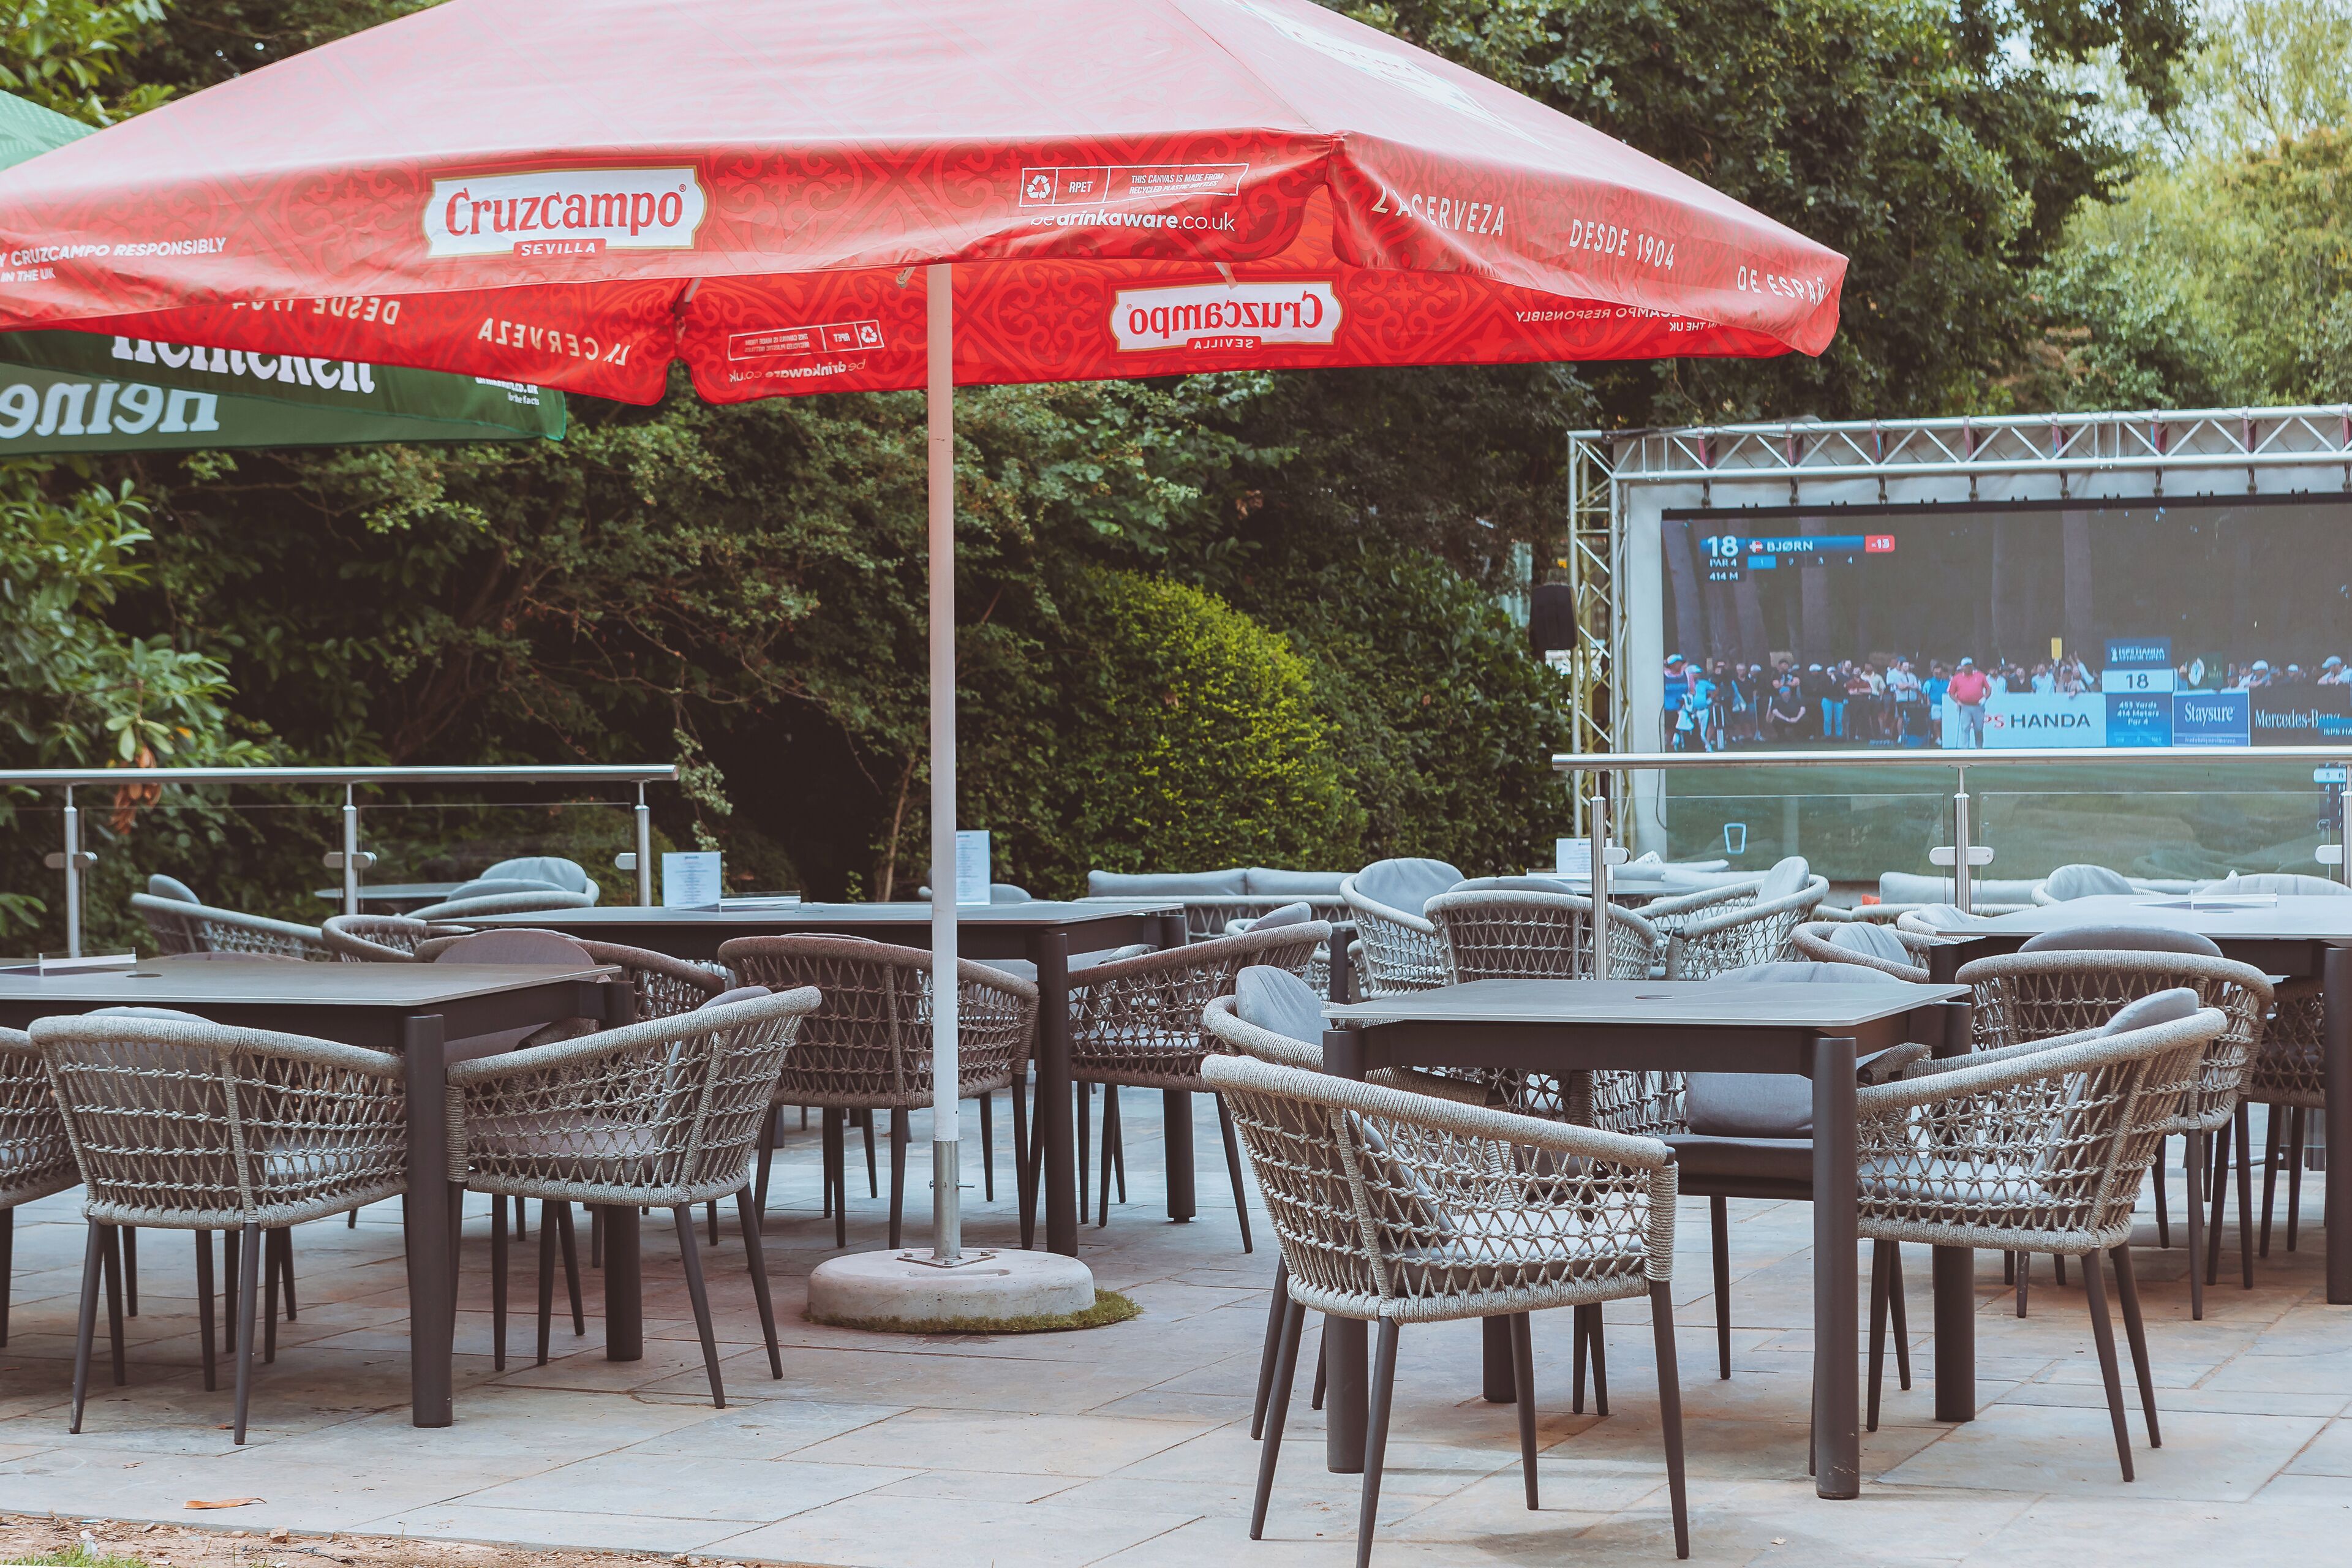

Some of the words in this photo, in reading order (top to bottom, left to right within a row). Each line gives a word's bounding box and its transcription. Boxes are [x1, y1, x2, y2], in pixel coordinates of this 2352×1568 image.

[1131, 175, 1146, 184] THIS
[1148, 174, 1175, 183] CANVAS
[1176, 174, 1183, 183] IS
[1184, 173, 1203, 182] MADE
[1204, 173, 1224, 181] FROM
[1069, 180, 1093, 194] RPET
[1129, 186, 1162, 195] RECYCLED
[1162, 183, 1189, 192] PLASTIC
[445, 187, 684, 237] Cruzcampo
[1371, 185, 1412, 217] LA
[1411, 194, 1504, 236] CERVEZA
[11, 244, 110, 266] CRUZCAMPO
[113, 236, 227, 257] RESPONSIBLY
[521, 243, 596, 257] SEVILLA
[1569, 219, 1627, 257] DESDE
[1637, 233, 1676, 271] 1904
[1, 271, 15, 282] IN
[17, 269, 39, 282] THE
[40, 267, 56, 280] UK
[1737, 265, 1762, 293] DE
[1766, 274, 1831, 306] ESPAÑ
[1707, 535, 1739, 558] 18
[1766, 540, 1813, 553] BJØRN
[1709, 559, 1728, 568] PAR
[1709, 572, 1727, 581] 414
[1729, 571, 1738, 581] M
[2125, 673, 2149, 689] 18
[1984, 715, 2005, 729] PS
[2010, 713, 2090, 728] HANDA
[2184, 701, 2234, 727] Staysure
